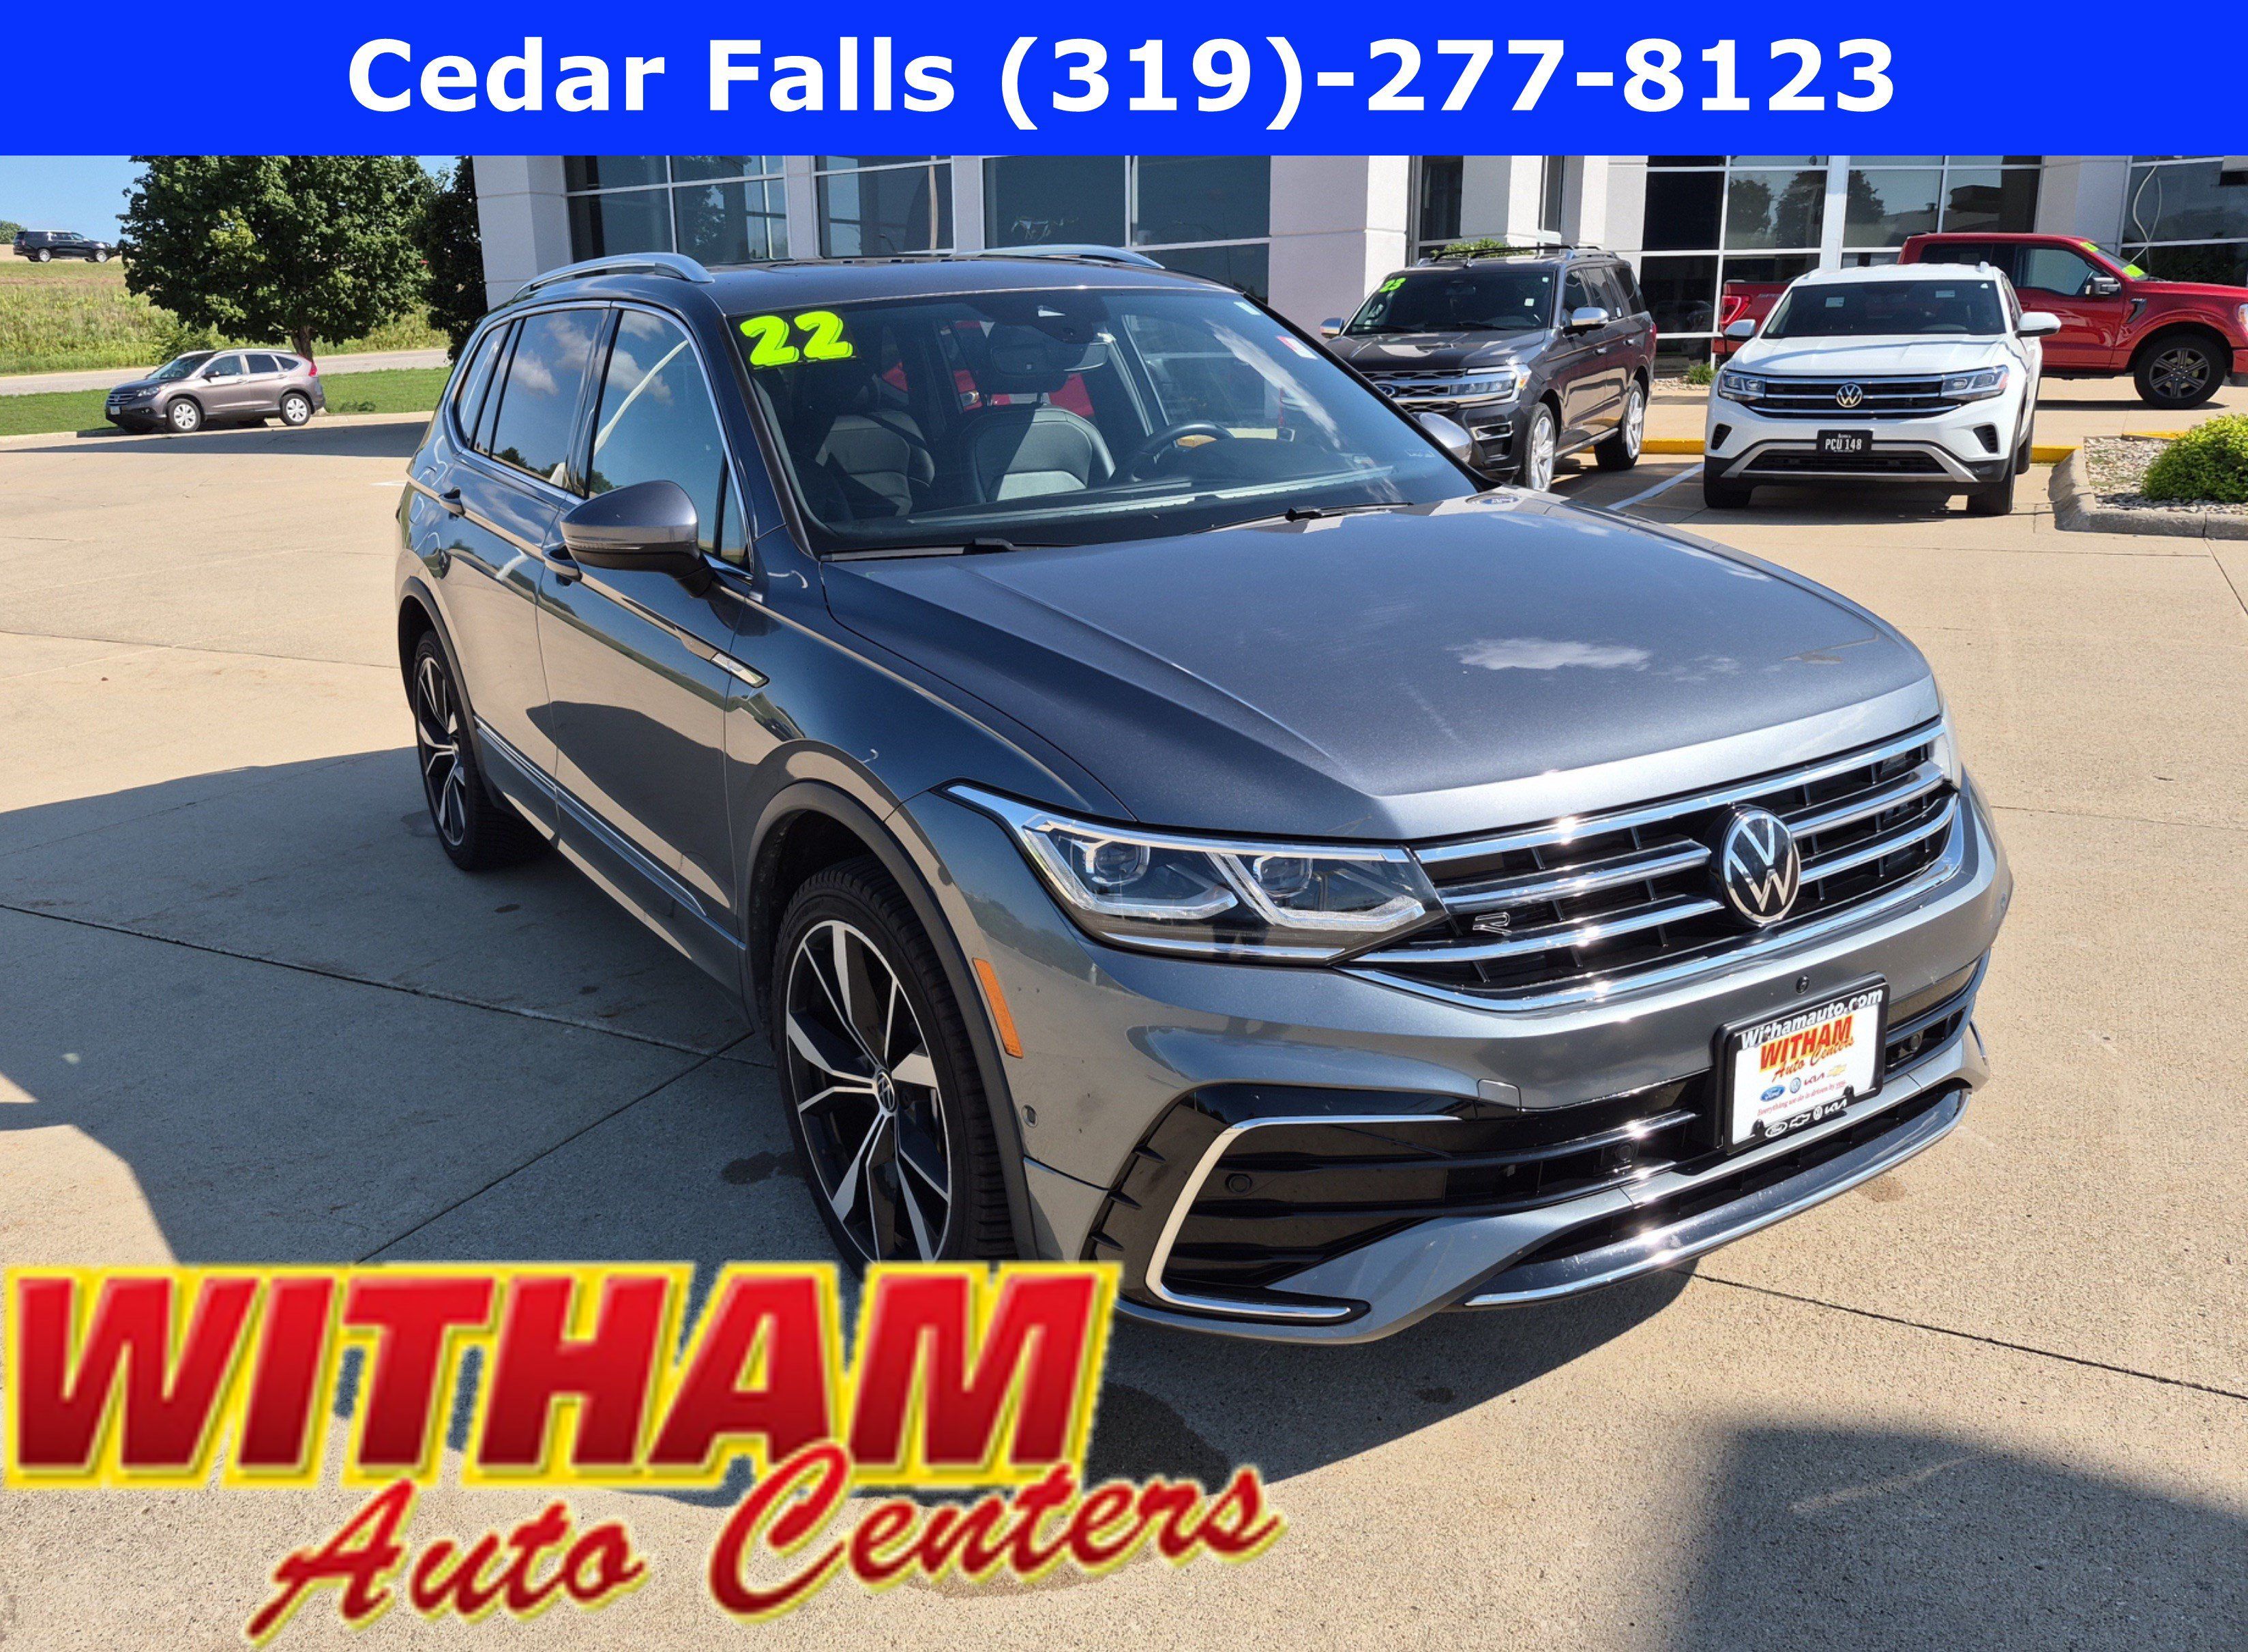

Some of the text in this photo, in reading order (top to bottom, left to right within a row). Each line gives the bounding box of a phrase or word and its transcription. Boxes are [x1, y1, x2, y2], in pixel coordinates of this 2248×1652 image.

[740, 310, 853, 366] 22
[1825, 439, 1862, 450] PCU 148
[1760, 1015, 1854, 1071] WITHAM
[1771, 1036, 1854, 1083] Auto Centers
